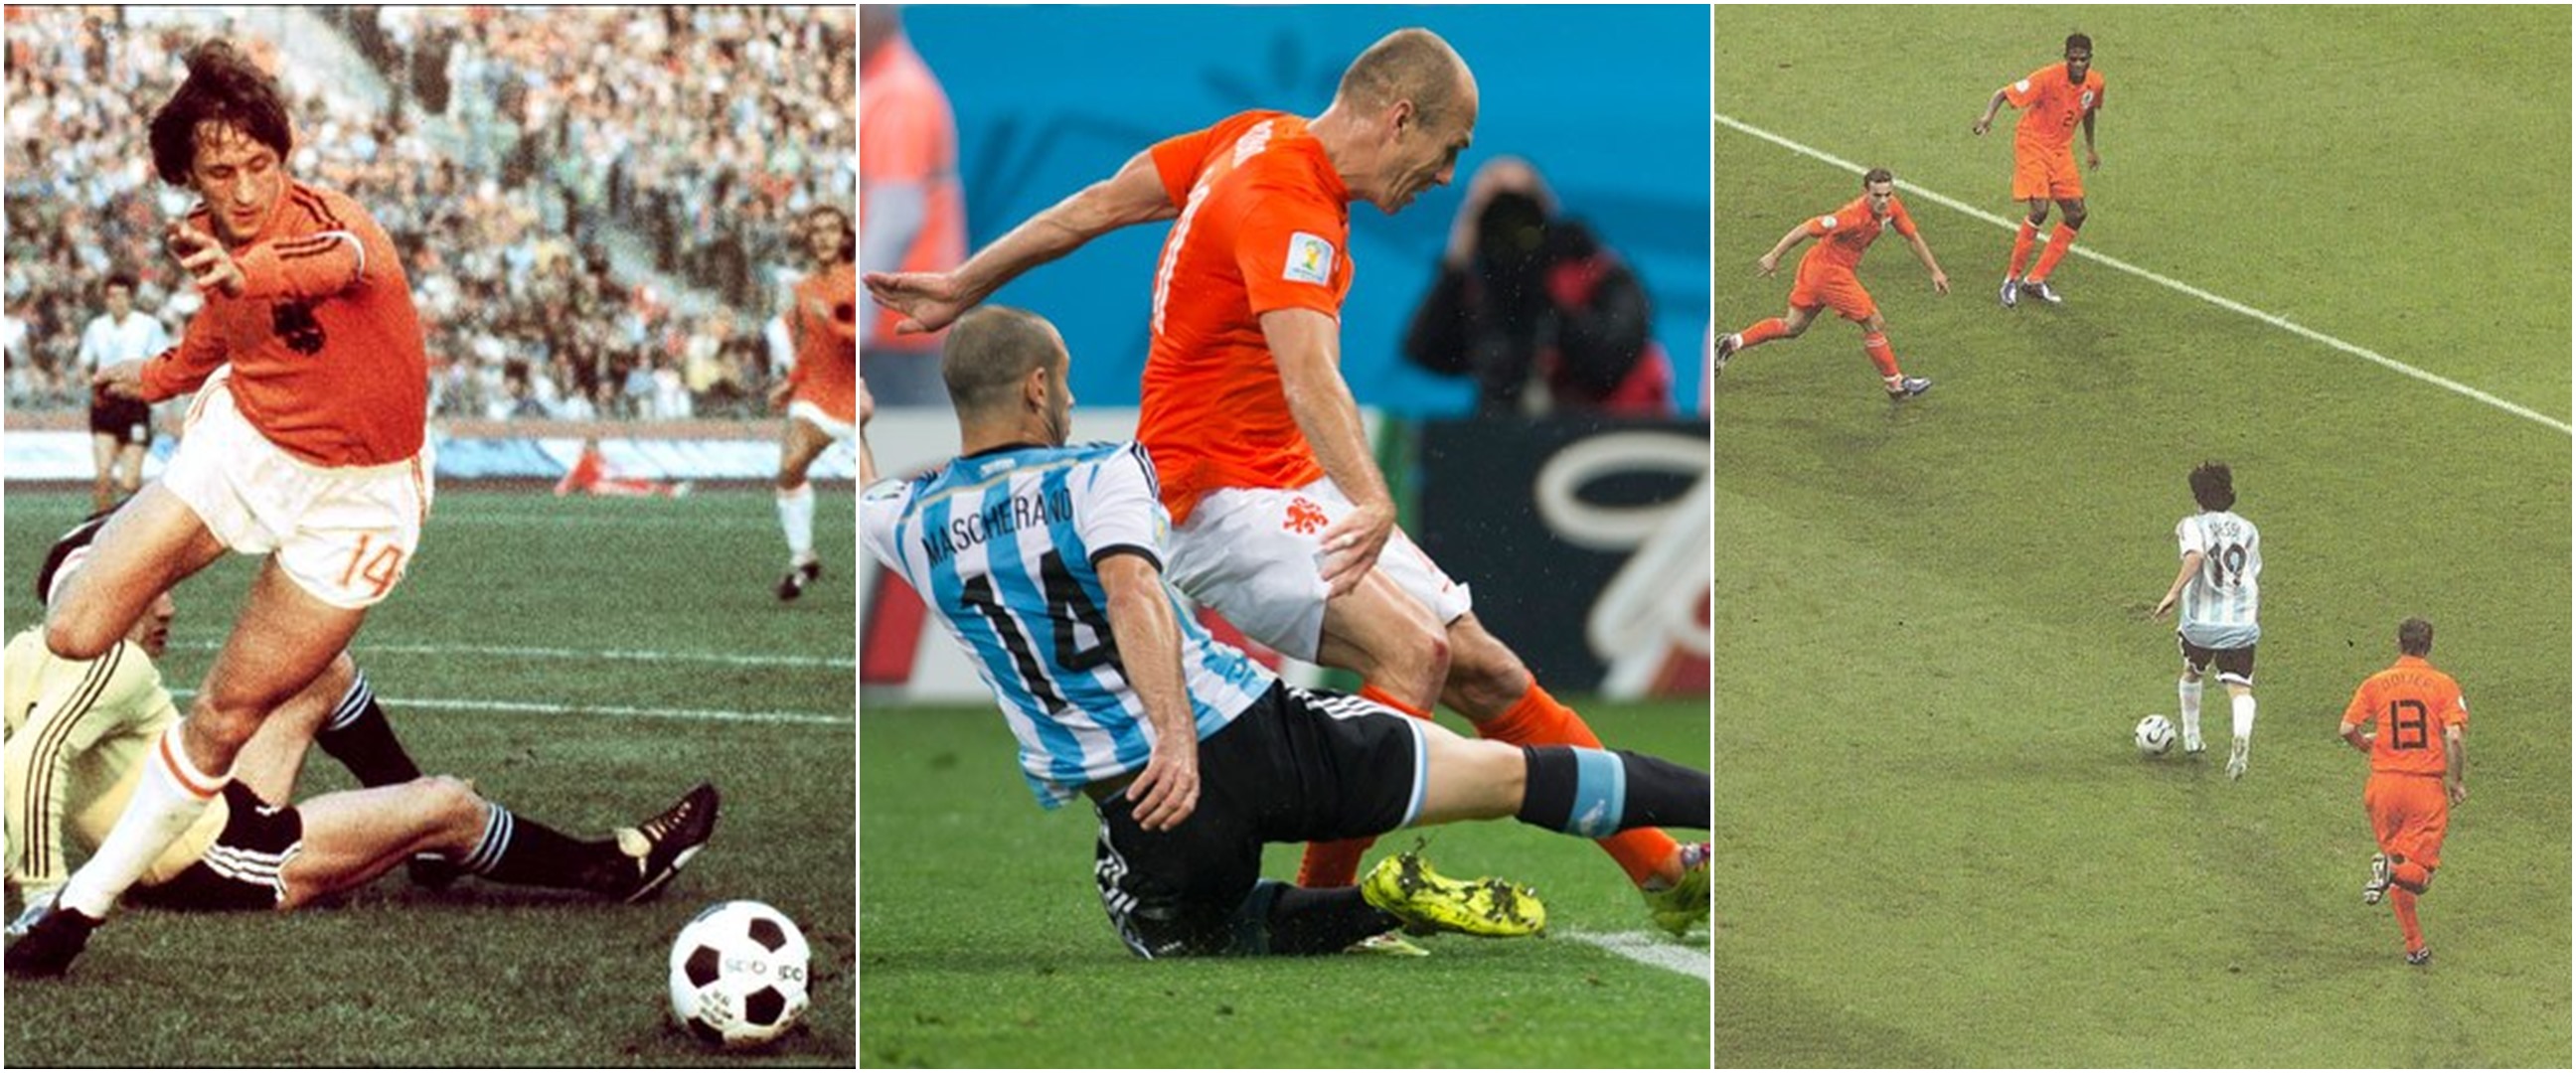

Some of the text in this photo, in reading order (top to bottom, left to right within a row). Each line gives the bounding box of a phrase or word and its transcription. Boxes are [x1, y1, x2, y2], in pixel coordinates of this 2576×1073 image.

[921, 487, 1073, 567] MASCHERANO
[339, 534, 402, 597] 14
[961, 549, 1131, 715] 14
[2391, 699, 2427, 750] 13
